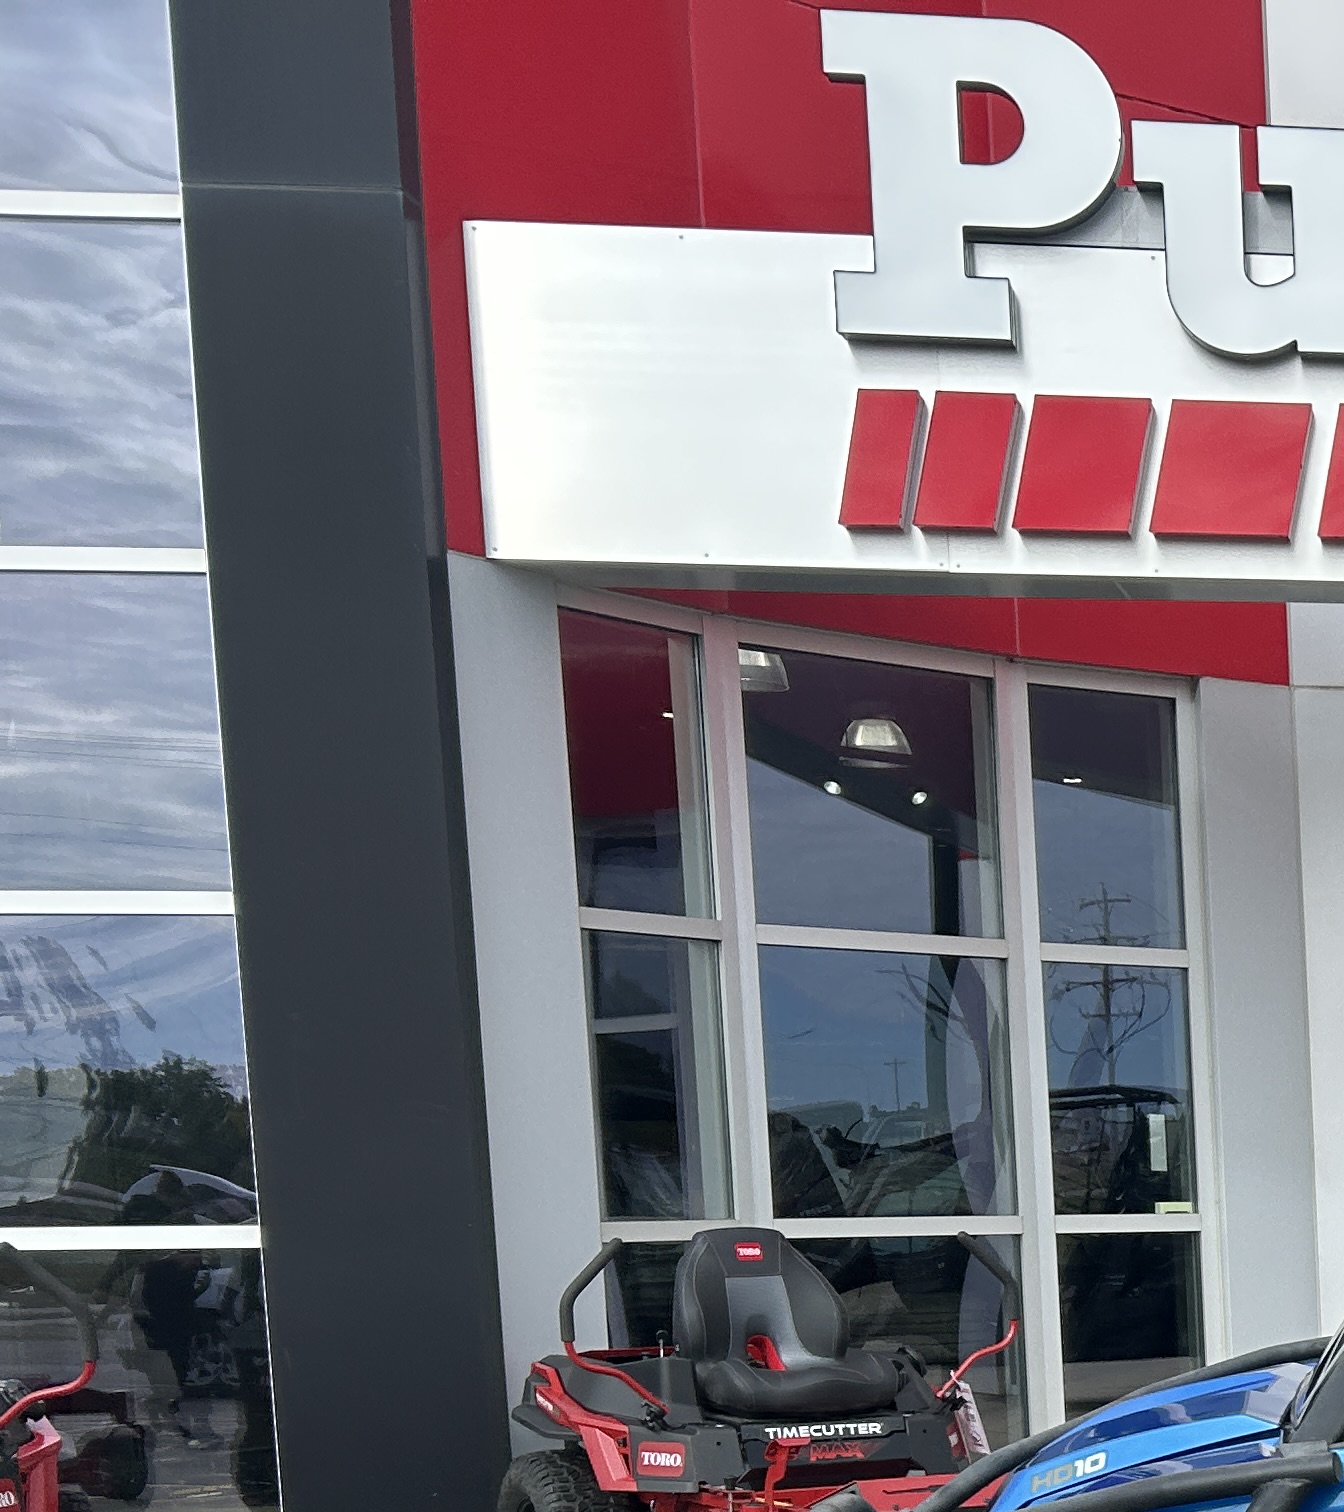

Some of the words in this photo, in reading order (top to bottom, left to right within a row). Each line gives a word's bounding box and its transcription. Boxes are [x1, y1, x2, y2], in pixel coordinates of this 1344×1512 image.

[764, 1422, 883, 1440] TIMECUTTER
[641, 1450, 682, 1468] TORO
[810, 1441, 865, 1463] MAX
[1031, 1451, 1107, 1493] HD10
